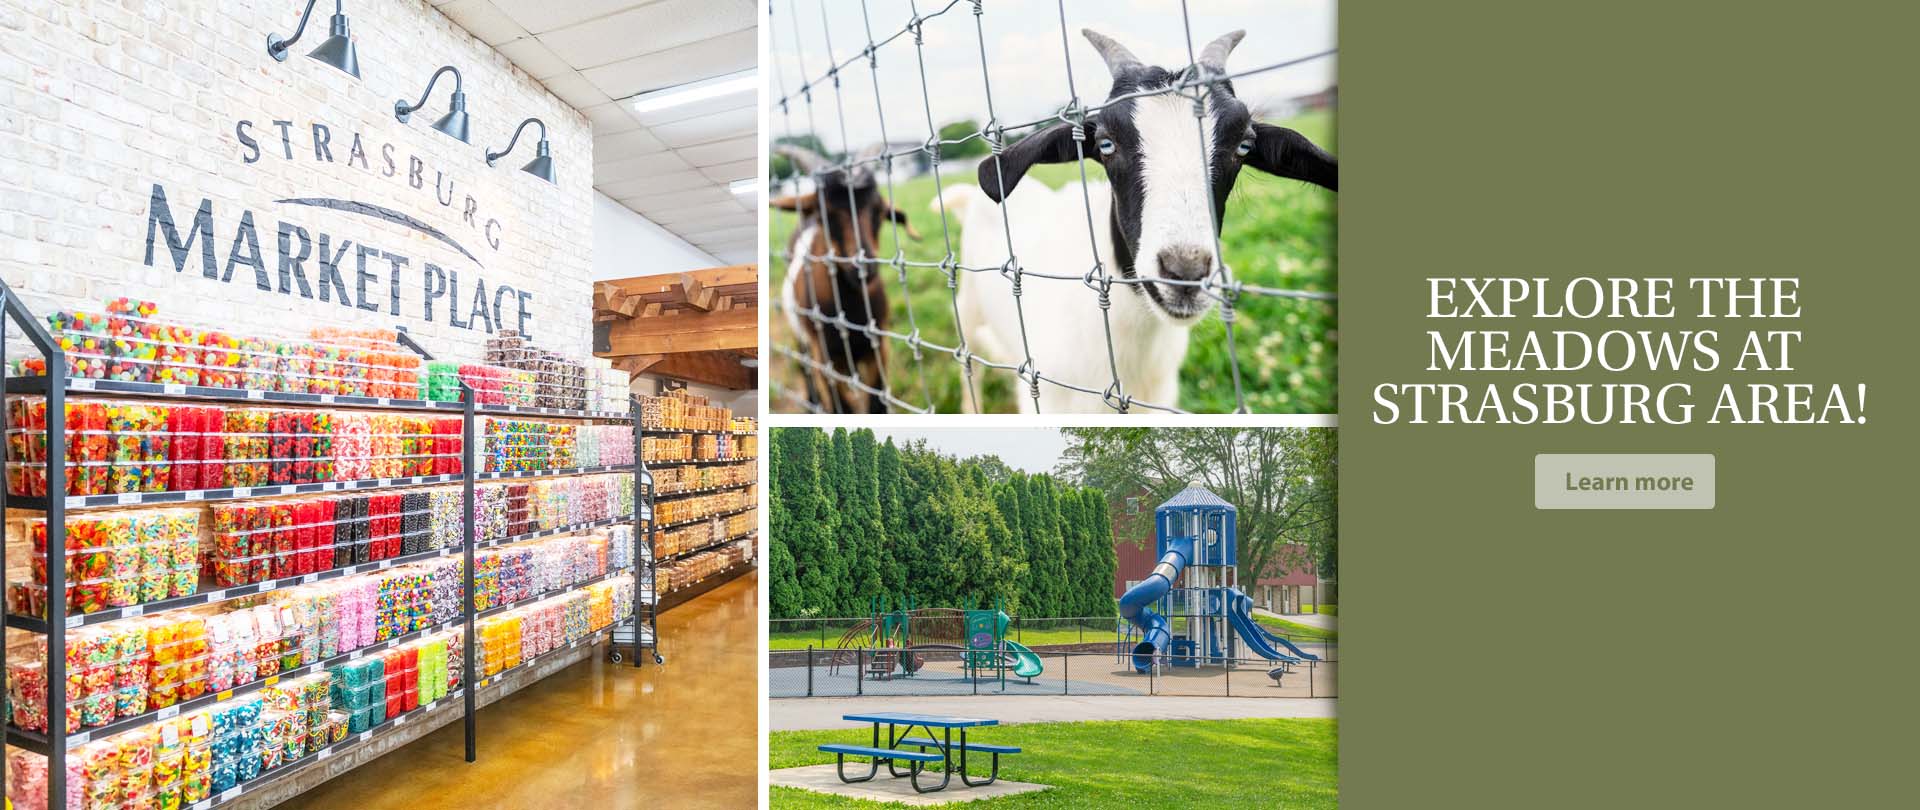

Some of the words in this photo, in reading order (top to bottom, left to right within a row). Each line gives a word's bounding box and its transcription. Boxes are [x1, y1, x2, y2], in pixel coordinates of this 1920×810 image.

[235, 119, 502, 252] STRASBURG
[144, 183, 410, 317] MARKET
[423, 262, 533, 342] PLACE
